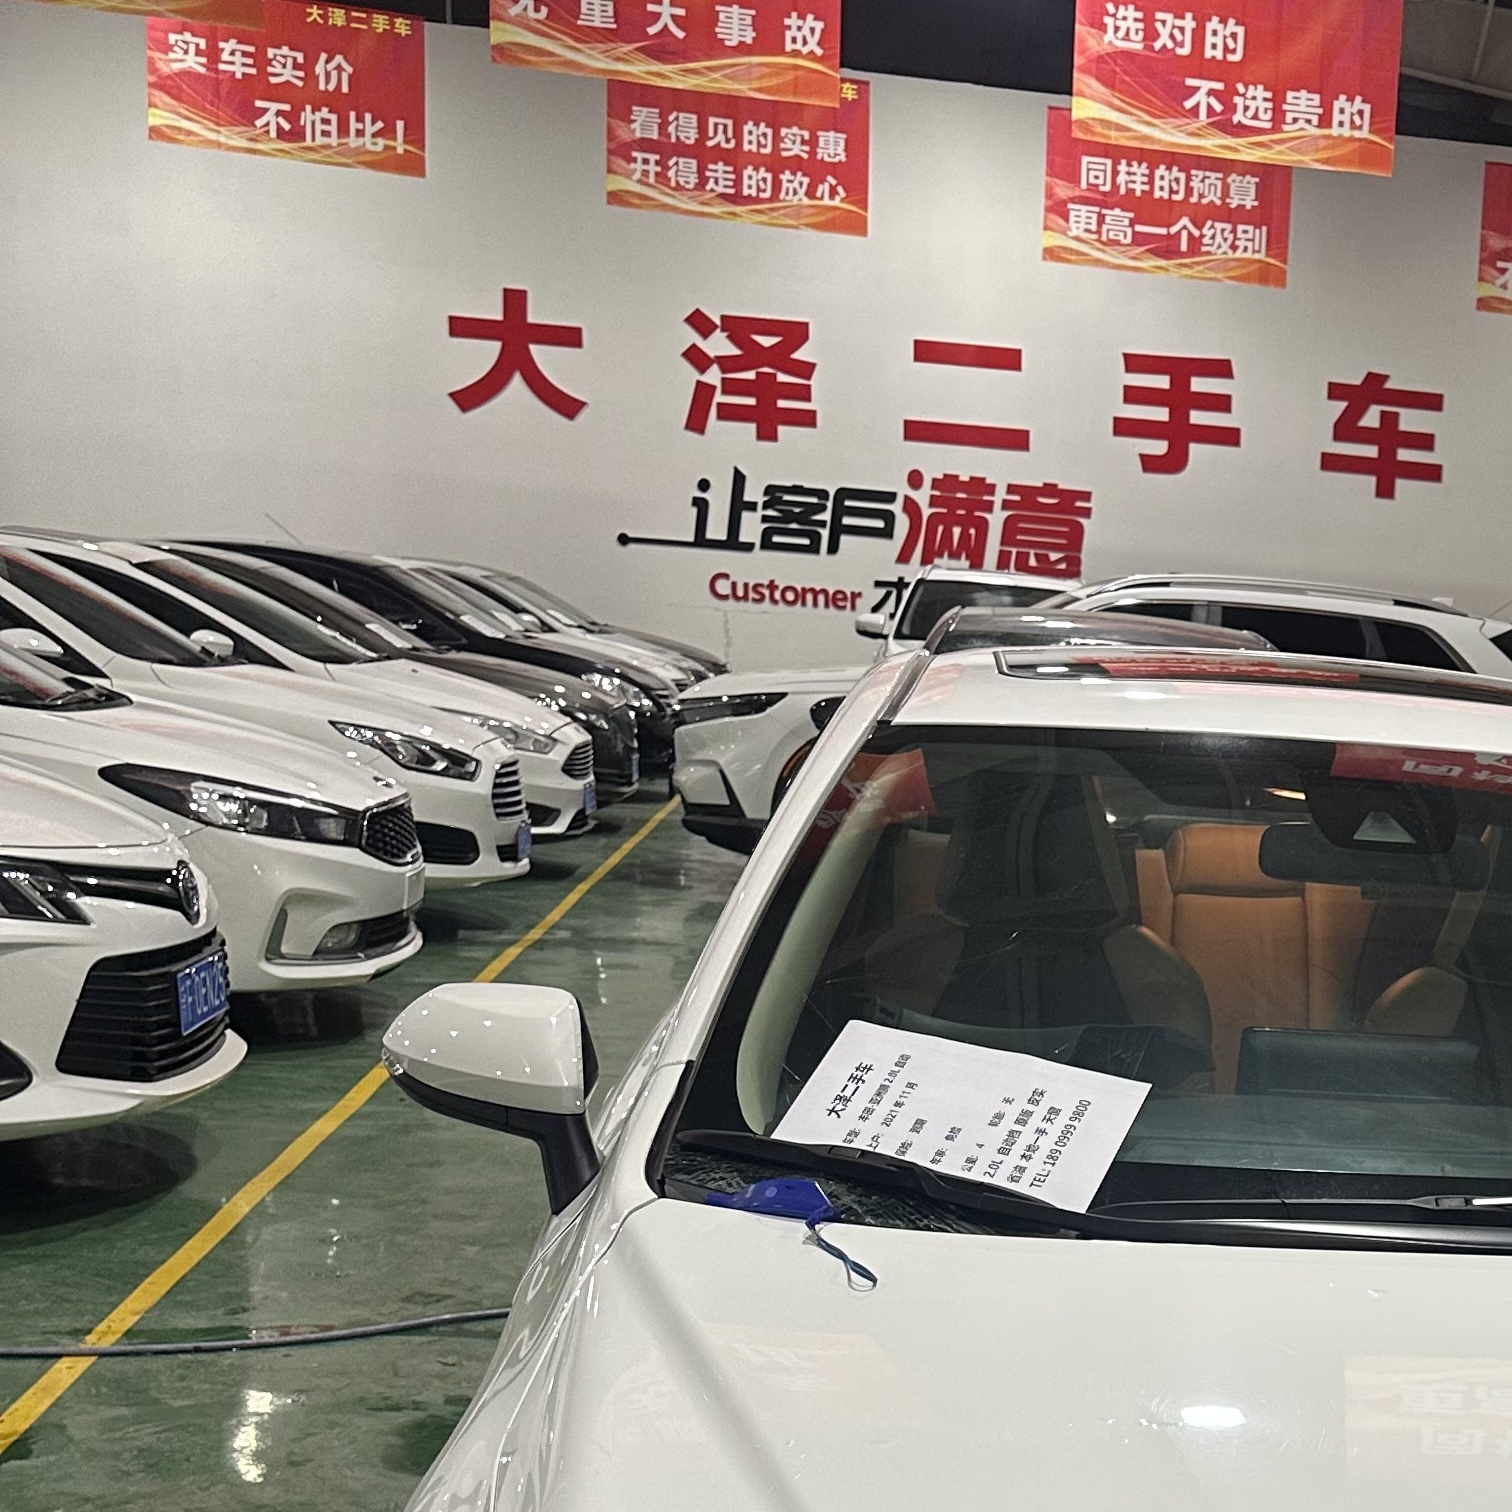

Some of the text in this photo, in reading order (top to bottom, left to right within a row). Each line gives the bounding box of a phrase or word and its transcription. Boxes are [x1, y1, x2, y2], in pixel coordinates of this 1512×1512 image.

[306, 5, 413, 36] 大泽二手车
[1102, 2, 1246, 62] 选对的
[167, 31, 354, 94] 实车实价
[629, 105, 847, 163] 看得见的实惠
[1182, 77, 1371, 138] 不选贵的
[629, 151, 847, 205] 开得走的放心
[1080, 155, 1260, 209] 同样的预算
[1066, 203, 1268, 257] 更高一个级别
[448, 287, 1444, 500] 大泽二手车
[709, 572, 863, 612] Customer
[826, 1062, 874, 1119] 大泽二手车
[881, 1110, 899, 1127] 2021
[1029, 1100, 1091, 1187] TEL: 189 0999 9800
[983, 1160, 1003, 1178] 2.0L
